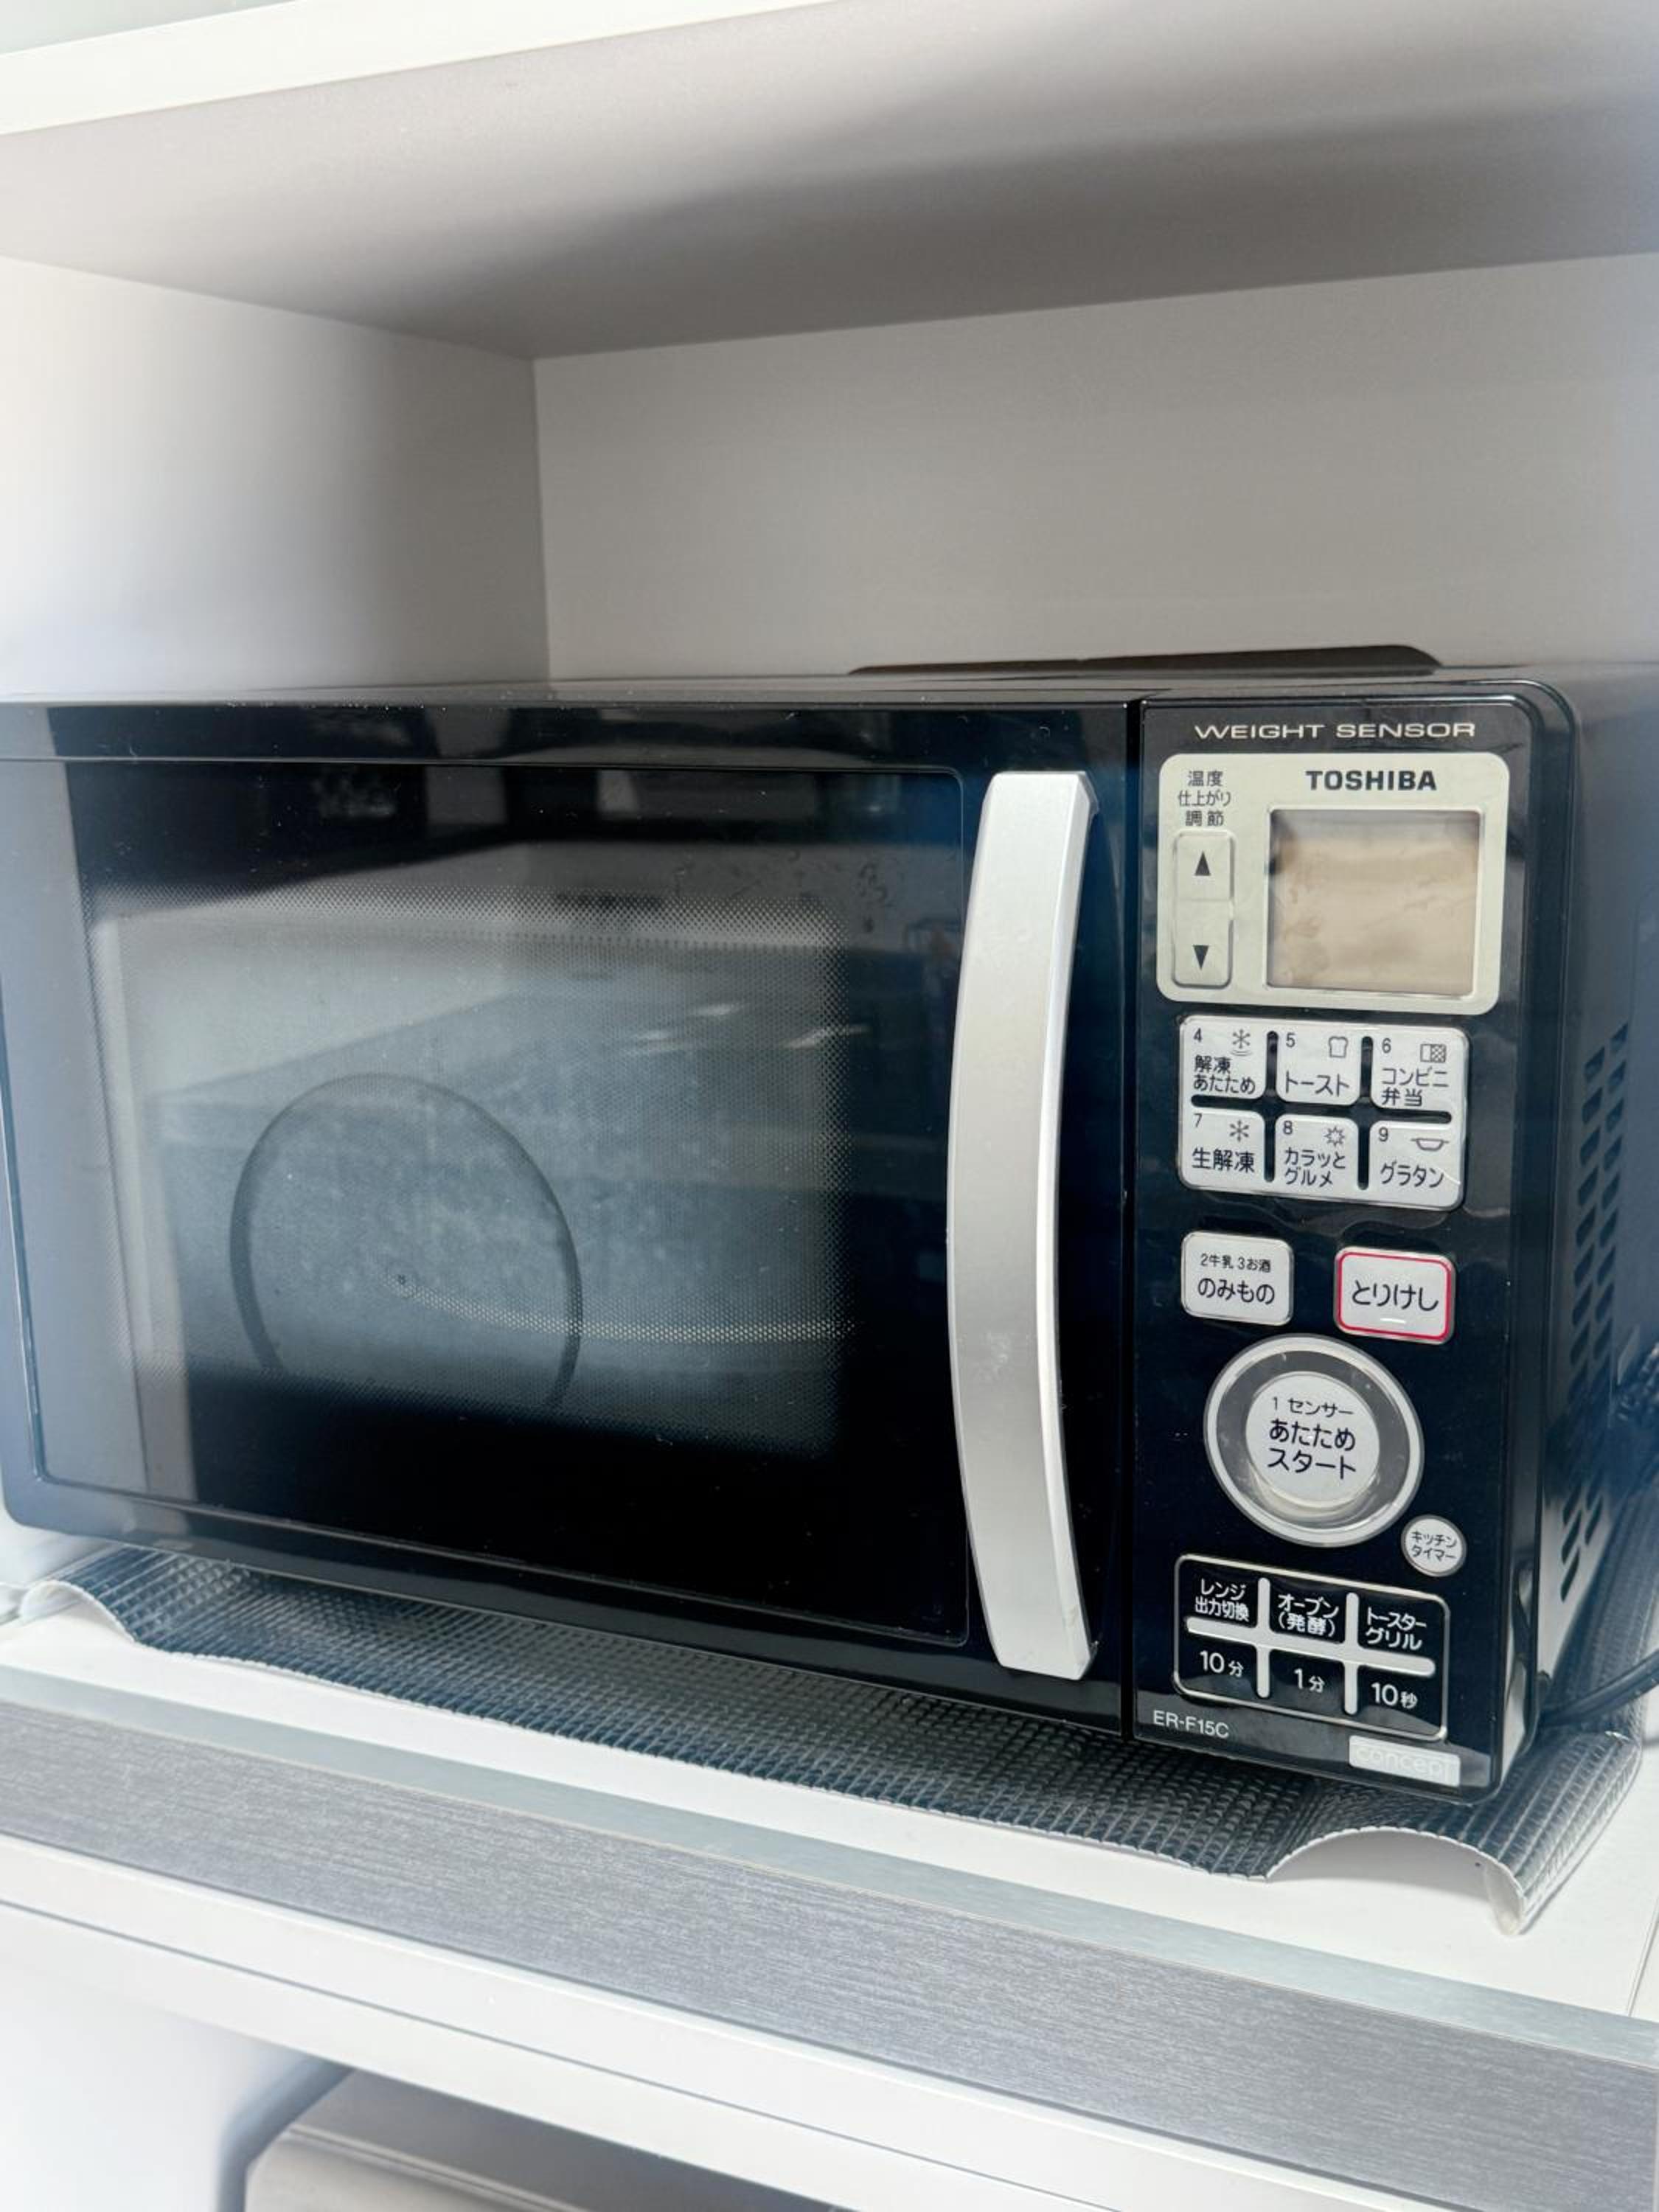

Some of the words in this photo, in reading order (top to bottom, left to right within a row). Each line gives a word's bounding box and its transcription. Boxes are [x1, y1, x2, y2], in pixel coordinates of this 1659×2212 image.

[1194, 724, 1325, 740] WEIGHT
[1335, 723, 1475, 738] SENSOR
[1187, 771, 1224, 787] 温度
[1305, 771, 1437, 791] TOSHIBA
[1178, 790, 1231, 807] 仕上がり
[1185, 810, 1224, 827] 調節
[1193, 1029, 1203, 1043] 4
[1285, 1033, 1295, 1048] 5
[1382, 1038, 1391, 1053] 6
[1194, 1054, 1231, 1074] 解凍
[1192, 1074, 1256, 1095] あたため
[1284, 1071, 1350, 1096] トースト
[1382, 1067, 1449, 1088] コンビニ
[1381, 1088, 1423, 1107] 弁当
[1193, 1114, 1203, 1127] 7
[1283, 1121, 1293, 1135] 8
[1379, 1127, 1389, 1141] 9
[1192, 1148, 1255, 1173] 生解凍
[1284, 1147, 1346, 1169] カラッと
[1284, 1167, 1334, 1187] グルメ
[1380, 1161, 1445, 1187] グラタン
[1197, 1278, 1275, 1304] のみもの
[1352, 1280, 1439, 1312] とりけし
[1289, 1397, 1354, 1418] センサー
[1268, 1419, 1356, 1451] あたため
[1267, 1447, 1356, 1480] スタート
[1411, 1530, 1458, 1547] キッチン
[1411, 1545, 1457, 1562] タイマー
[1200, 1579, 1247, 1599] レンジ
[1194, 1596, 1250, 1622] 出力切換
[1366, 1607, 1427, 1630] トースター
[1366, 1628, 1423, 1651] グリル
[1199, 1650, 1244, 1677] 10分
[1294, 1669, 1326, 1693] 1分
[1371, 1682, 1418, 1709] 10秒
[1152, 1710, 1230, 1739] ER-F15C
